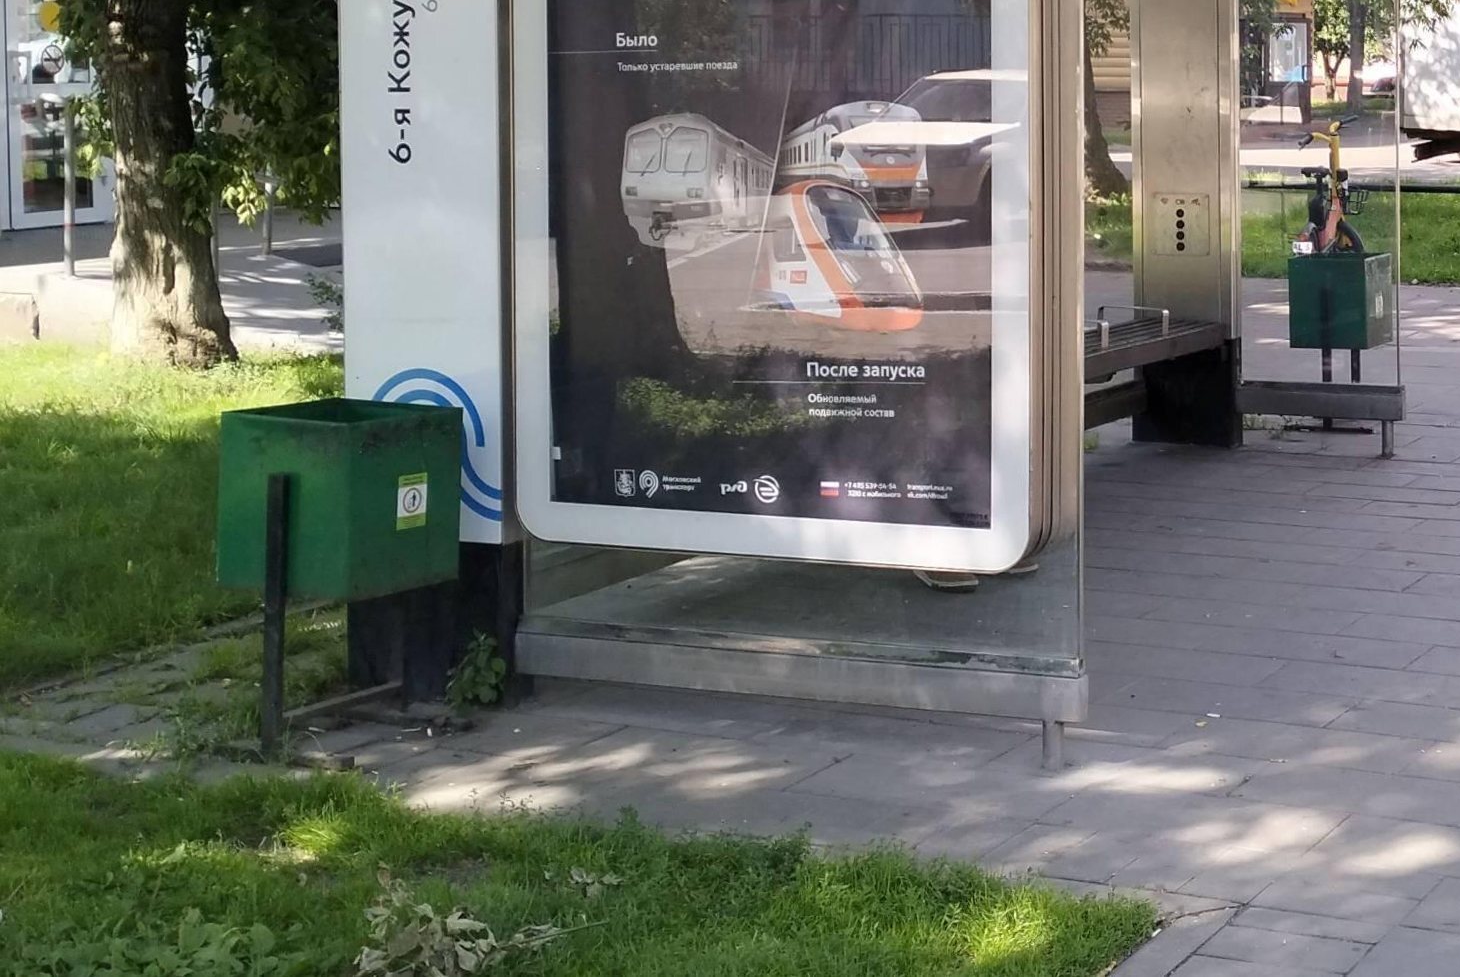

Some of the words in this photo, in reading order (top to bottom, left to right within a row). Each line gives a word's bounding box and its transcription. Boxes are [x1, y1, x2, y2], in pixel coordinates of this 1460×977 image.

[615, 32, 658, 47] Было
[617, 61, 649, 72] Только
[649, 61, 704, 73] устаревшие
[705, 61, 739, 71] поезда
[388, 108, 412, 164] 6-я
[806, 361, 859, 377] После
[862, 364, 926, 380] запуска
[807, 393, 877, 404] Обновляемый
[808, 406, 863, 418] подвижной
[864, 408, 895, 418] состав
